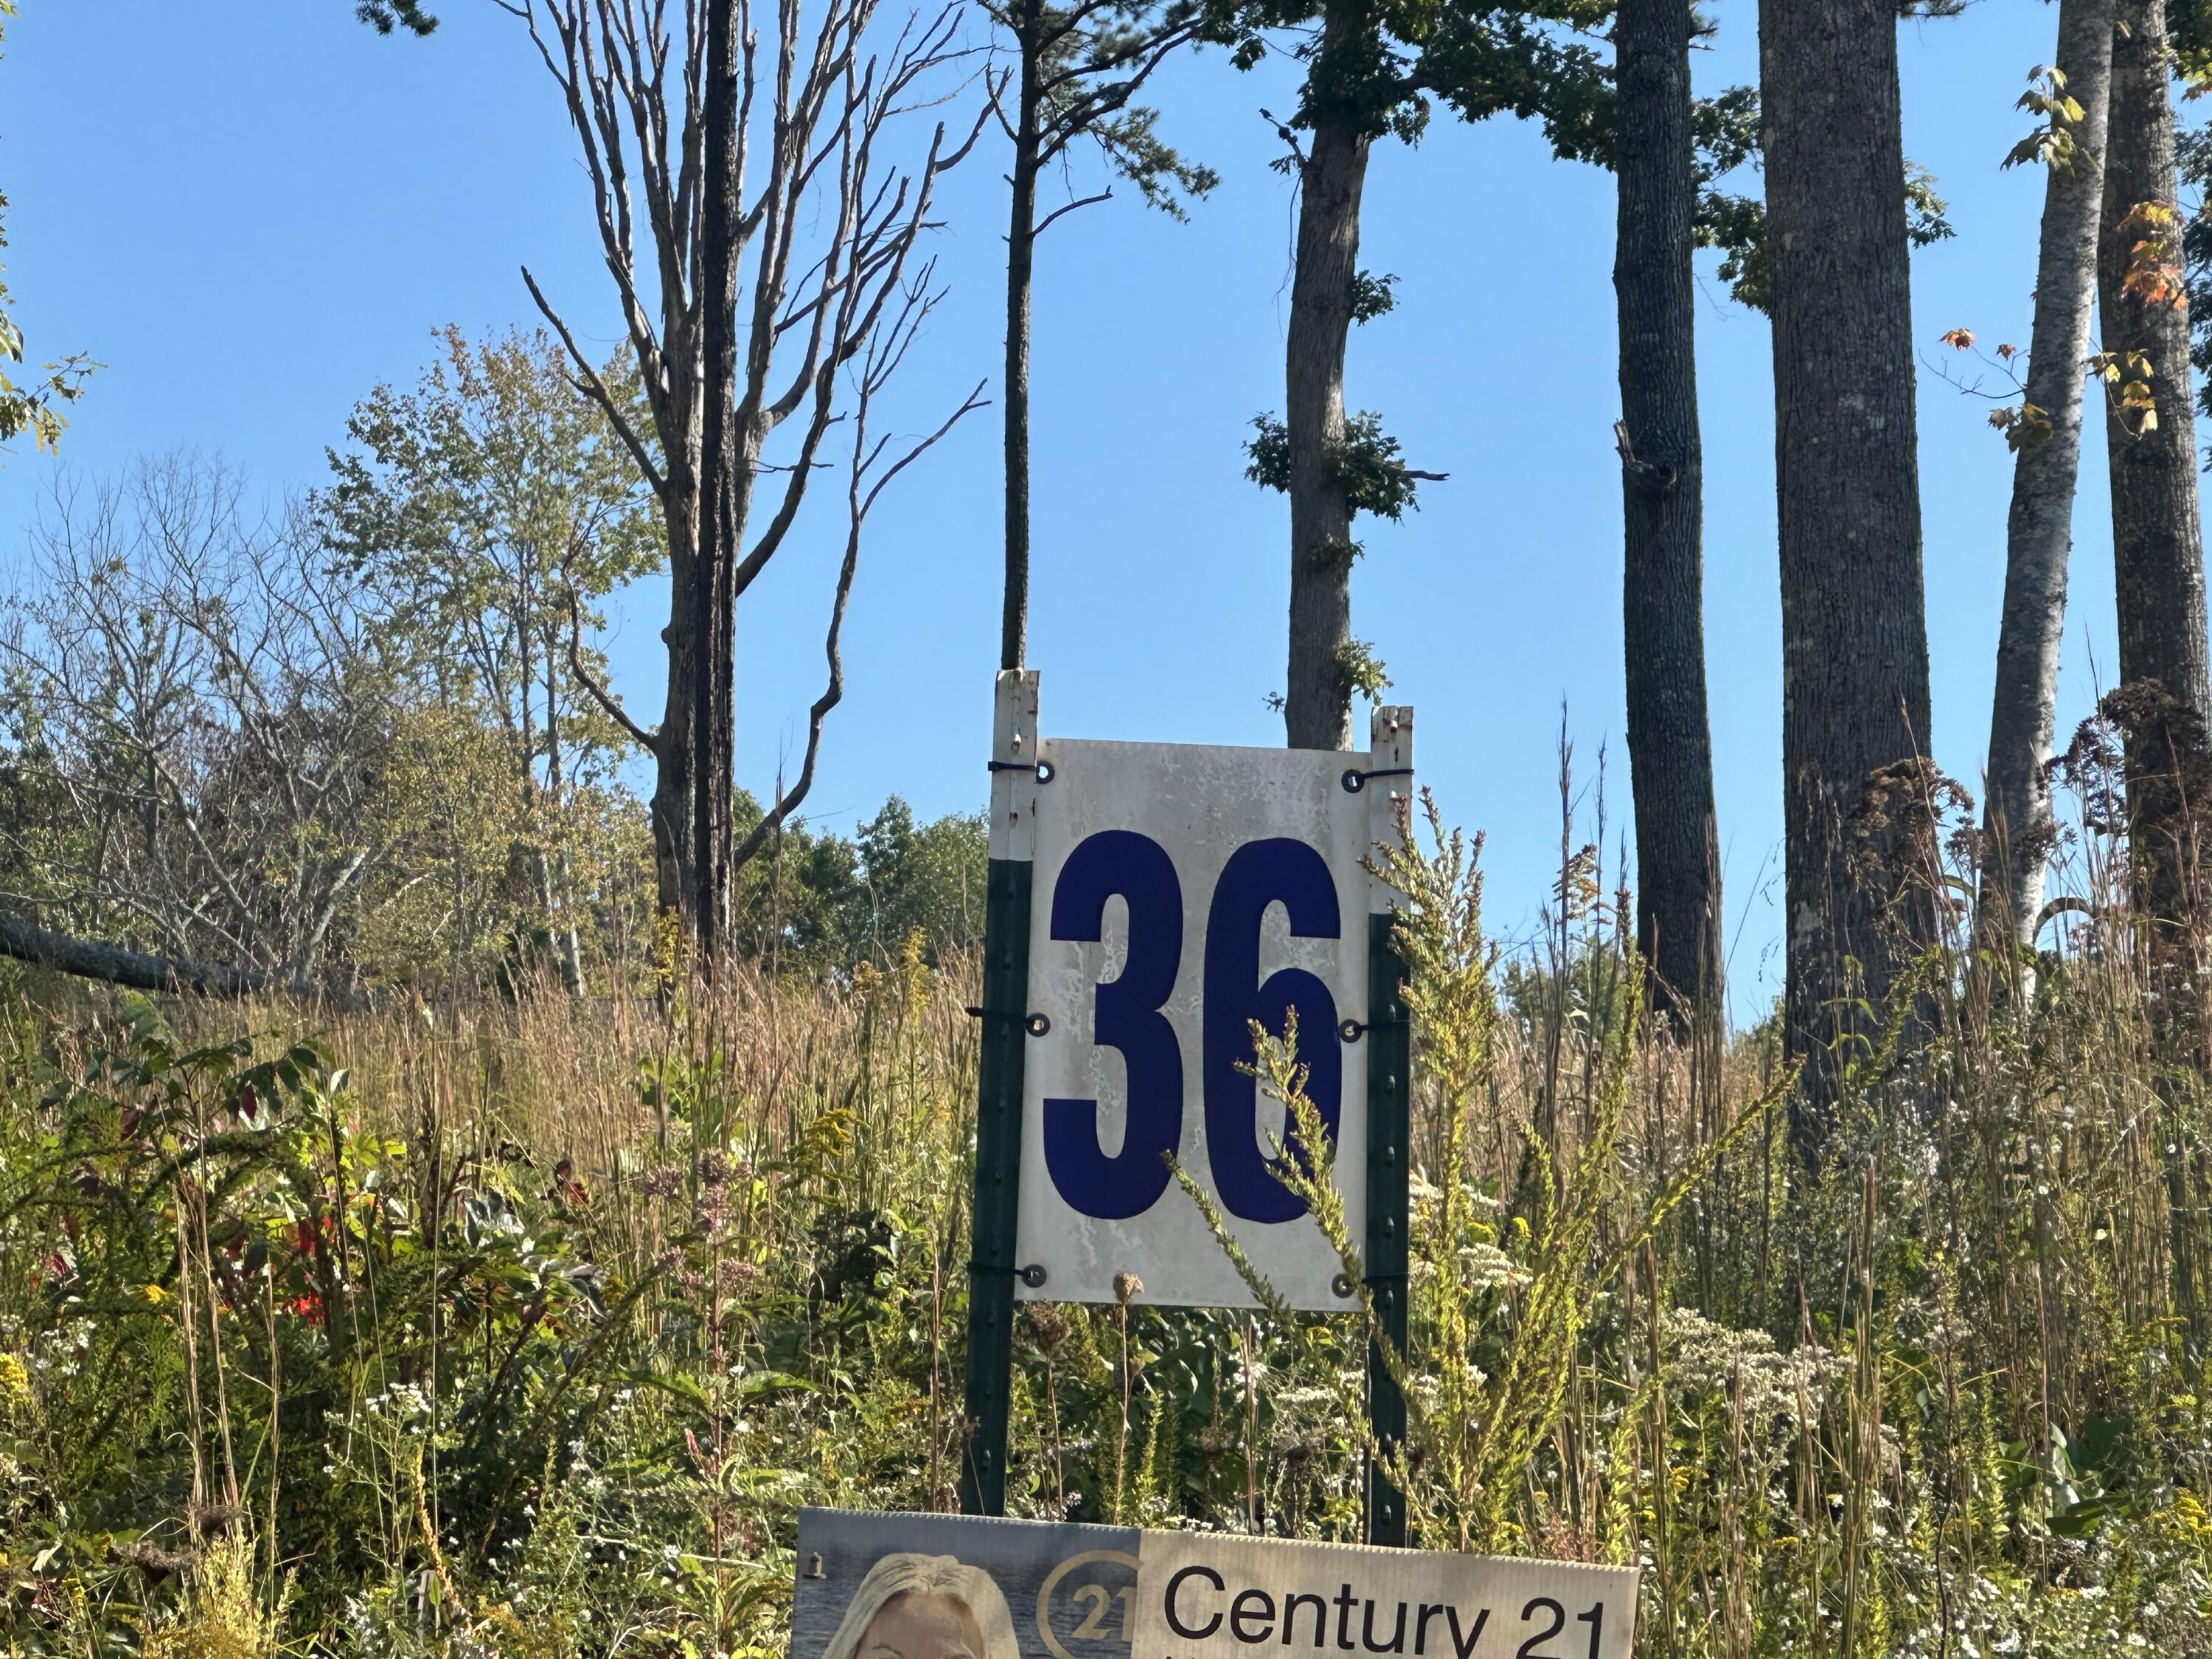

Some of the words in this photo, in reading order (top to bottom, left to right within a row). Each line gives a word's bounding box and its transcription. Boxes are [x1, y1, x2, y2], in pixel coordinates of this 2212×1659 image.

[1043, 830, 1343, 1224] 36
[1071, 1584, 1138, 1642] 21
[1164, 1565, 1490, 1659] Century
[1516, 1597, 1604, 1659] 21
